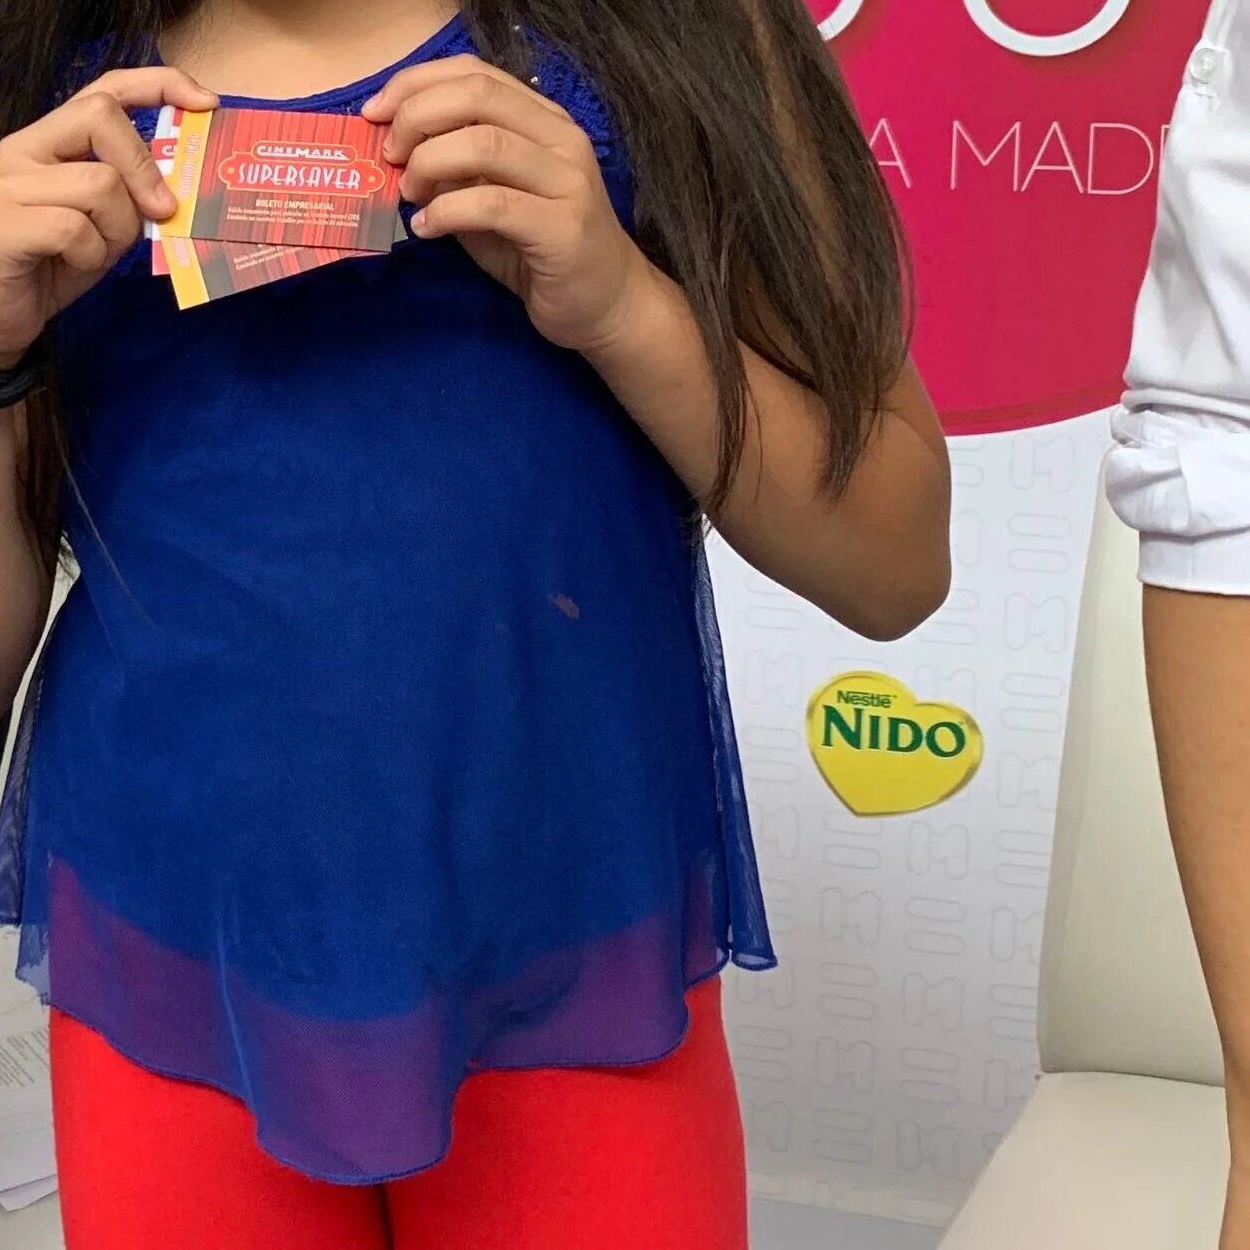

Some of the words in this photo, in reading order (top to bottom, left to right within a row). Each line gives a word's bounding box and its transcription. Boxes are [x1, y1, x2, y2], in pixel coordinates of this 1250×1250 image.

[256, 145, 350, 161] CINEMARK
[951, 120, 1173, 195] MAD
[238, 162, 361, 191] SUPERSAVER
[255, 199, 284, 209] BOLETO
[284, 200, 335, 211] EMPRESARIAL
[822, 704, 967, 759] NIDO
